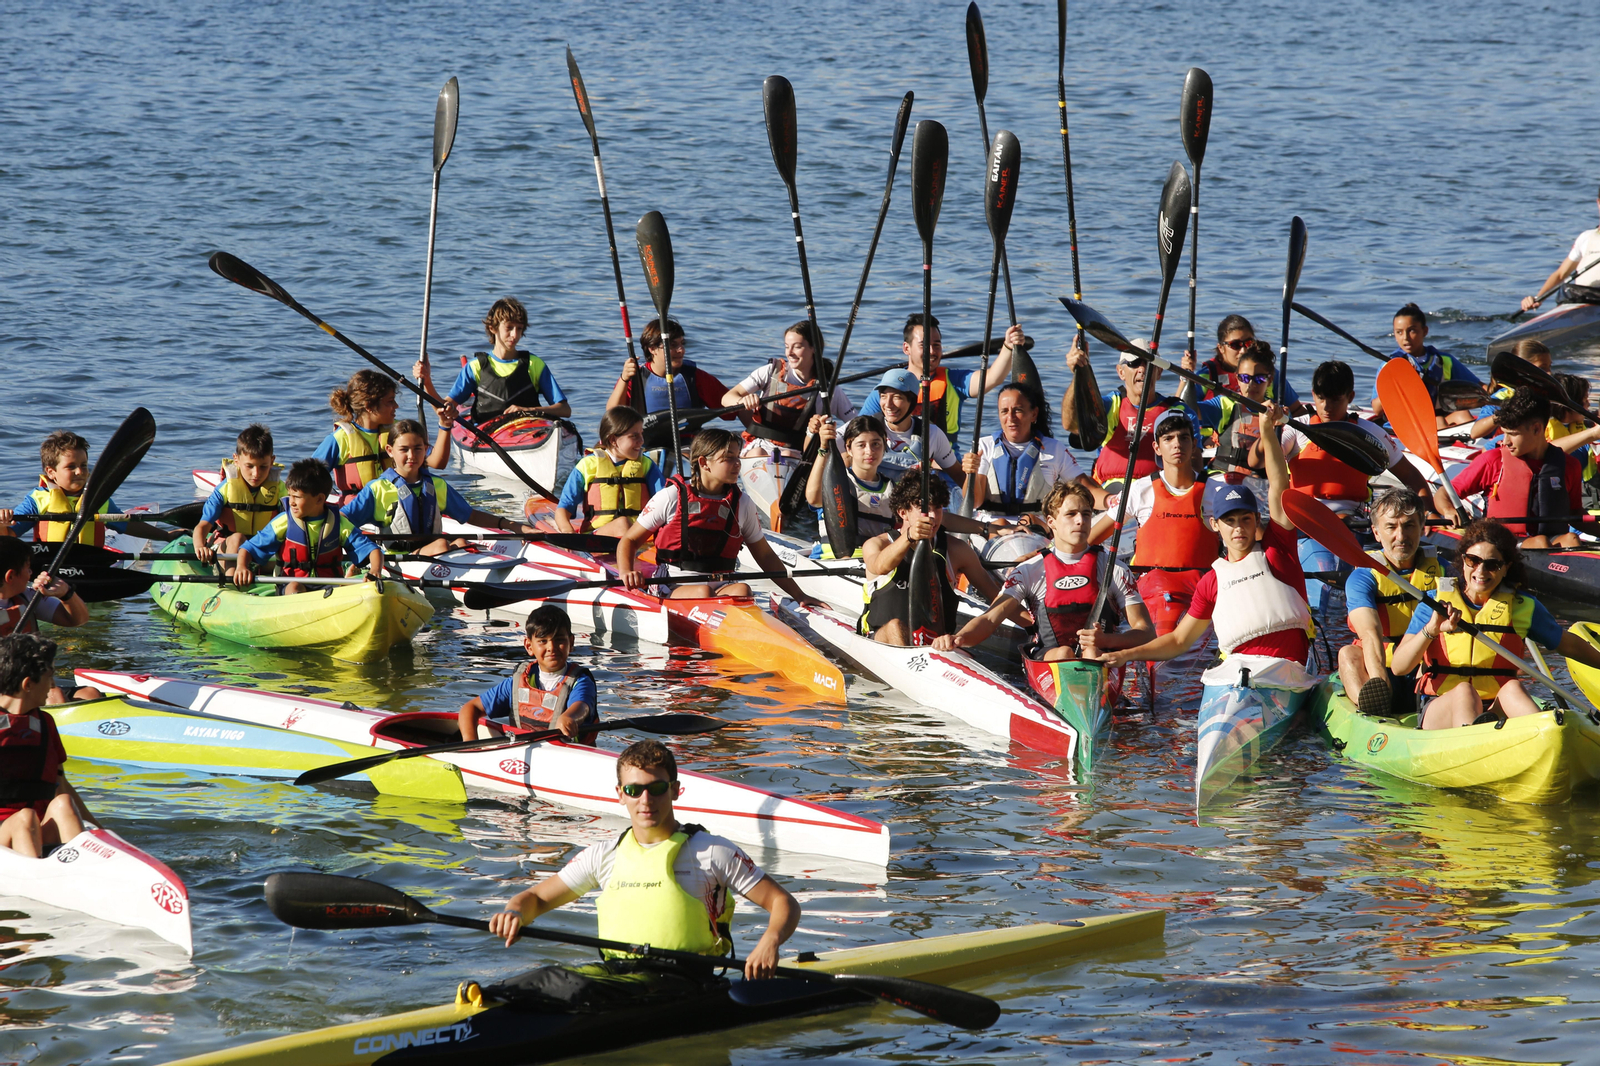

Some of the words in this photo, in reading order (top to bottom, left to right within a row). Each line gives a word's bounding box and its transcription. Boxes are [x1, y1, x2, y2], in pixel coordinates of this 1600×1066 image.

[1193, 98, 1205, 137] KAINER
[996, 168, 1009, 208] KAINER
[644, 244, 660, 287] KAINER
[833, 484, 845, 528] KAINER
[58, 566, 85, 578] RTM
[1550, 563, 1568, 572] NELO
[1056, 576, 1088, 589] SIPRE
[814, 671, 838, 690] MACH
[98, 719, 131, 737] SIPRE
[183, 725, 219, 739] KAYAK
[219, 728, 246, 742] VIGO
[499, 758, 531, 775] SIPRE
[643, 880, 663, 890] sport
[151, 881, 183, 915] SIPRE
[325, 905, 390, 915] KAINER
[353, 1024, 467, 1056] CONNECT
